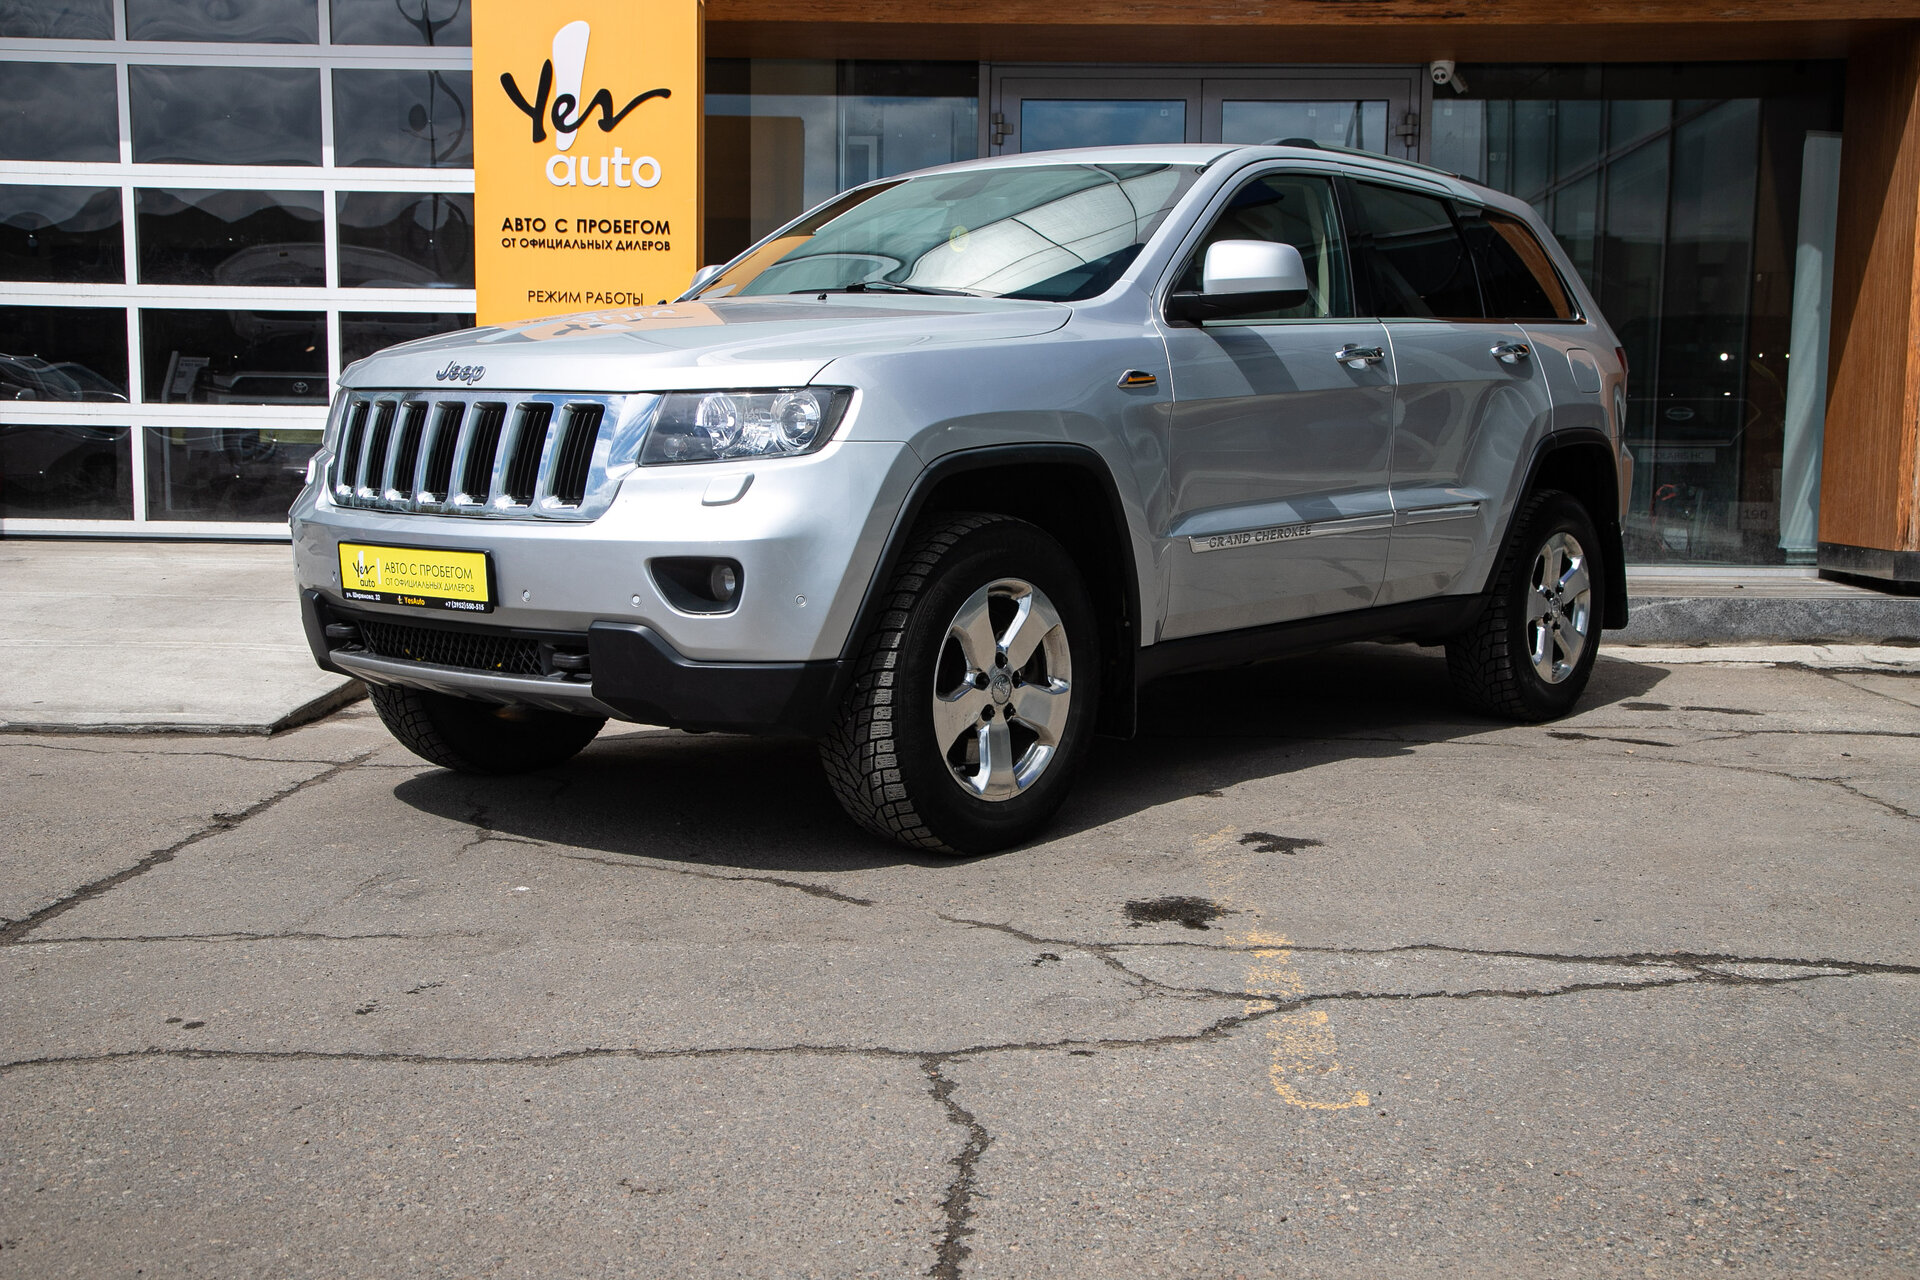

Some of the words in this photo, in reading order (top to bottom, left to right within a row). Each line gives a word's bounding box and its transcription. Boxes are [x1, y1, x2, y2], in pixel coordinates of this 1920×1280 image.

[545, 147, 661, 187] auto
[501, 217, 546, 232] АВТО
[555, 218, 568, 233] С
[577, 218, 670, 235] ПРОБЕГОМ
[501, 238, 516, 248] ОТ
[520, 238, 612, 250] ОФИЦИАЛЬНЫХ
[616, 240, 670, 251] ДИЛЕРОВ
[528, 290, 581, 304] РЕЖИМ
[586, 291, 643, 306] РАБОТЫ
[436, 360, 486, 386] Jeep
[1209, 533, 1250, 548] GRAND
[1255, 525, 1311, 542] CHEROKEE
[385, 562, 407, 575] АВТО
[410, 563, 417, 576] С
[420, 564, 473, 580] ПРОБЕГОМ
[360, 579, 375, 588] auto
[385, 577, 393, 586] ОТ
[394, 578, 442, 590] ОФИЦИАЛЬНЫХ
[444, 582, 475, 593] ДИЛЕРОВ
